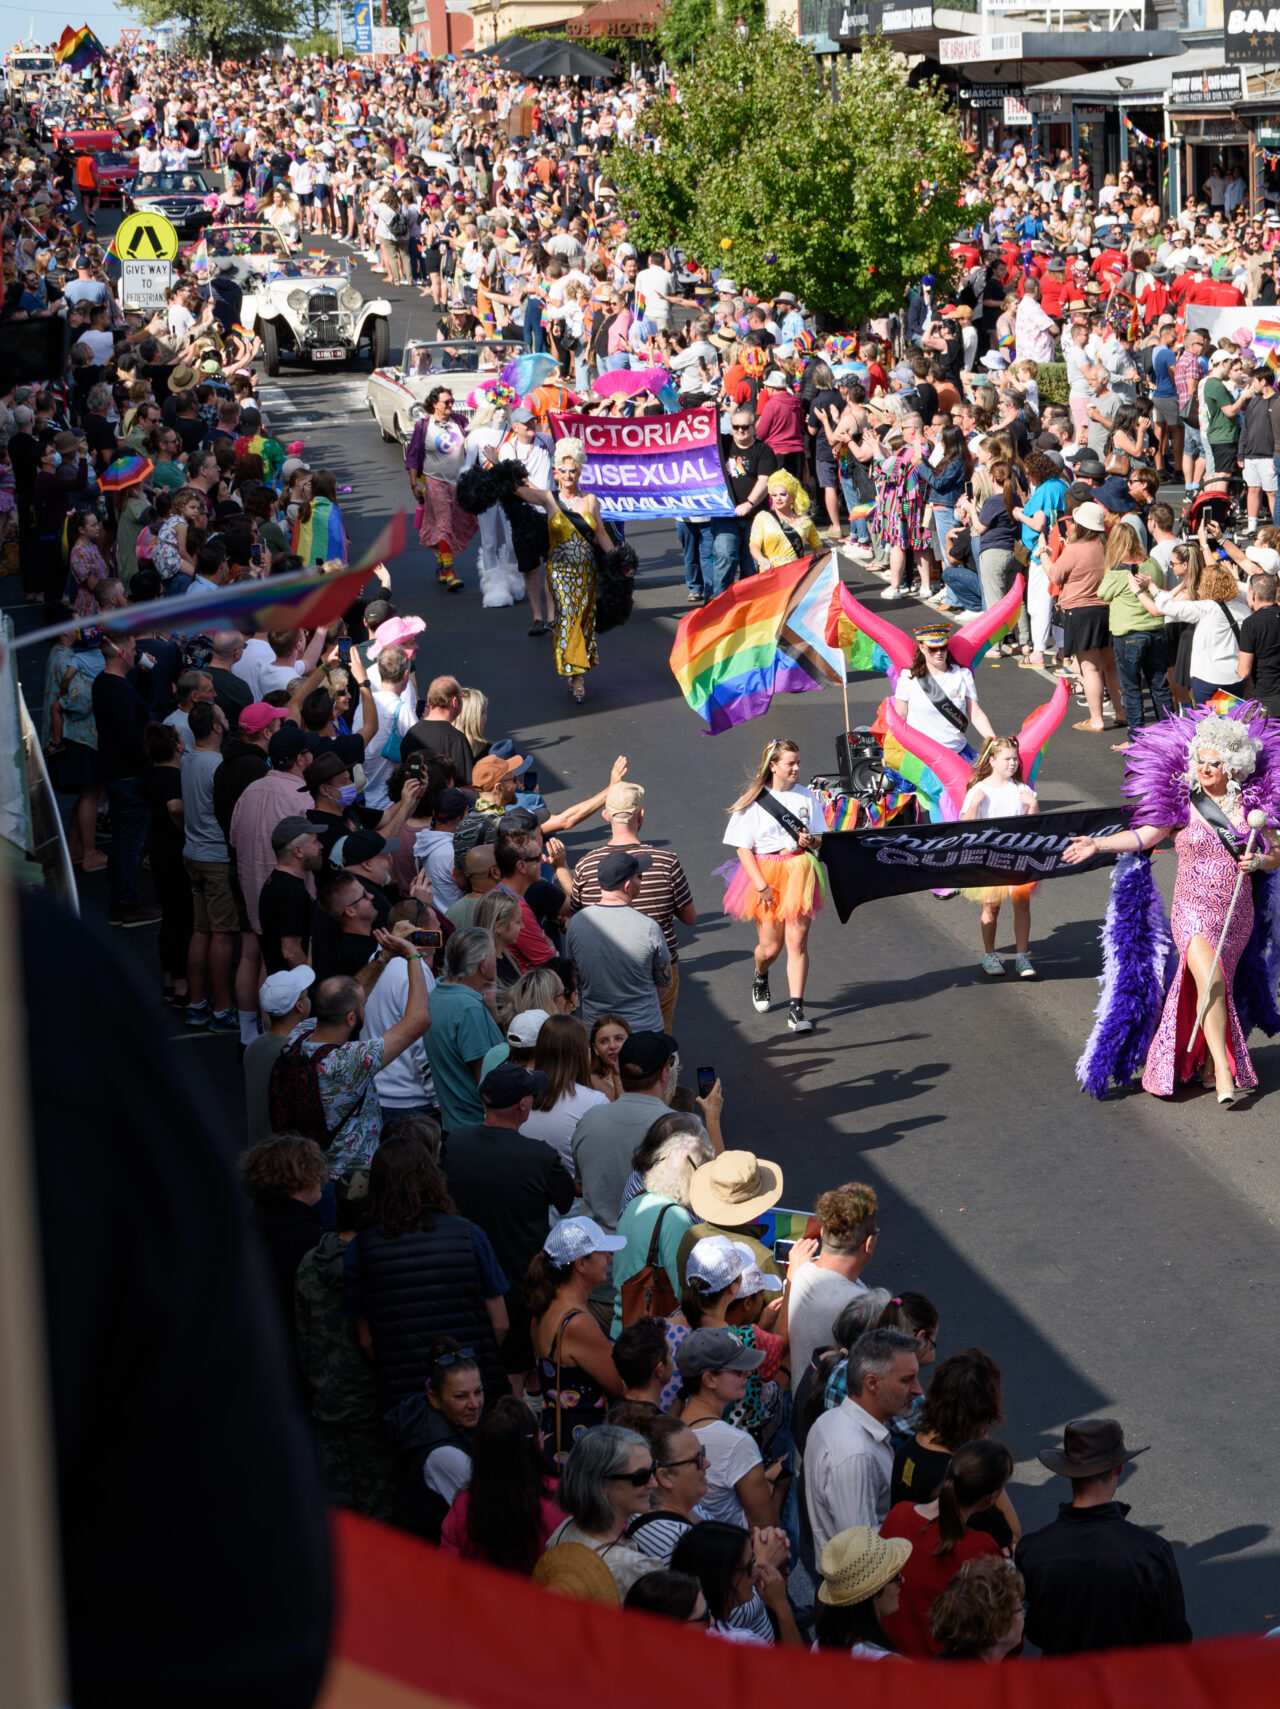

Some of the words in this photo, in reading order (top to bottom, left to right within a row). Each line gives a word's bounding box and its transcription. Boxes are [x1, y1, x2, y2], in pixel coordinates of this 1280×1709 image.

[607, 22, 656, 34] HOTE
[959, 88, 1022, 99] CHARGRILLED
[970, 99, 1003, 108] CHICKE
[1006, 96, 1030, 114] THAT
[125, 265, 146, 275] GIVE
[149, 264, 168, 275] WAY
[142, 279, 153, 289] TO
[558, 415, 711, 448] VICTORIA'S
[579, 458, 719, 487] BISEXUAL
[599, 489, 732, 513] OMMUNITY
[858, 822, 1123, 852] Entertainig
